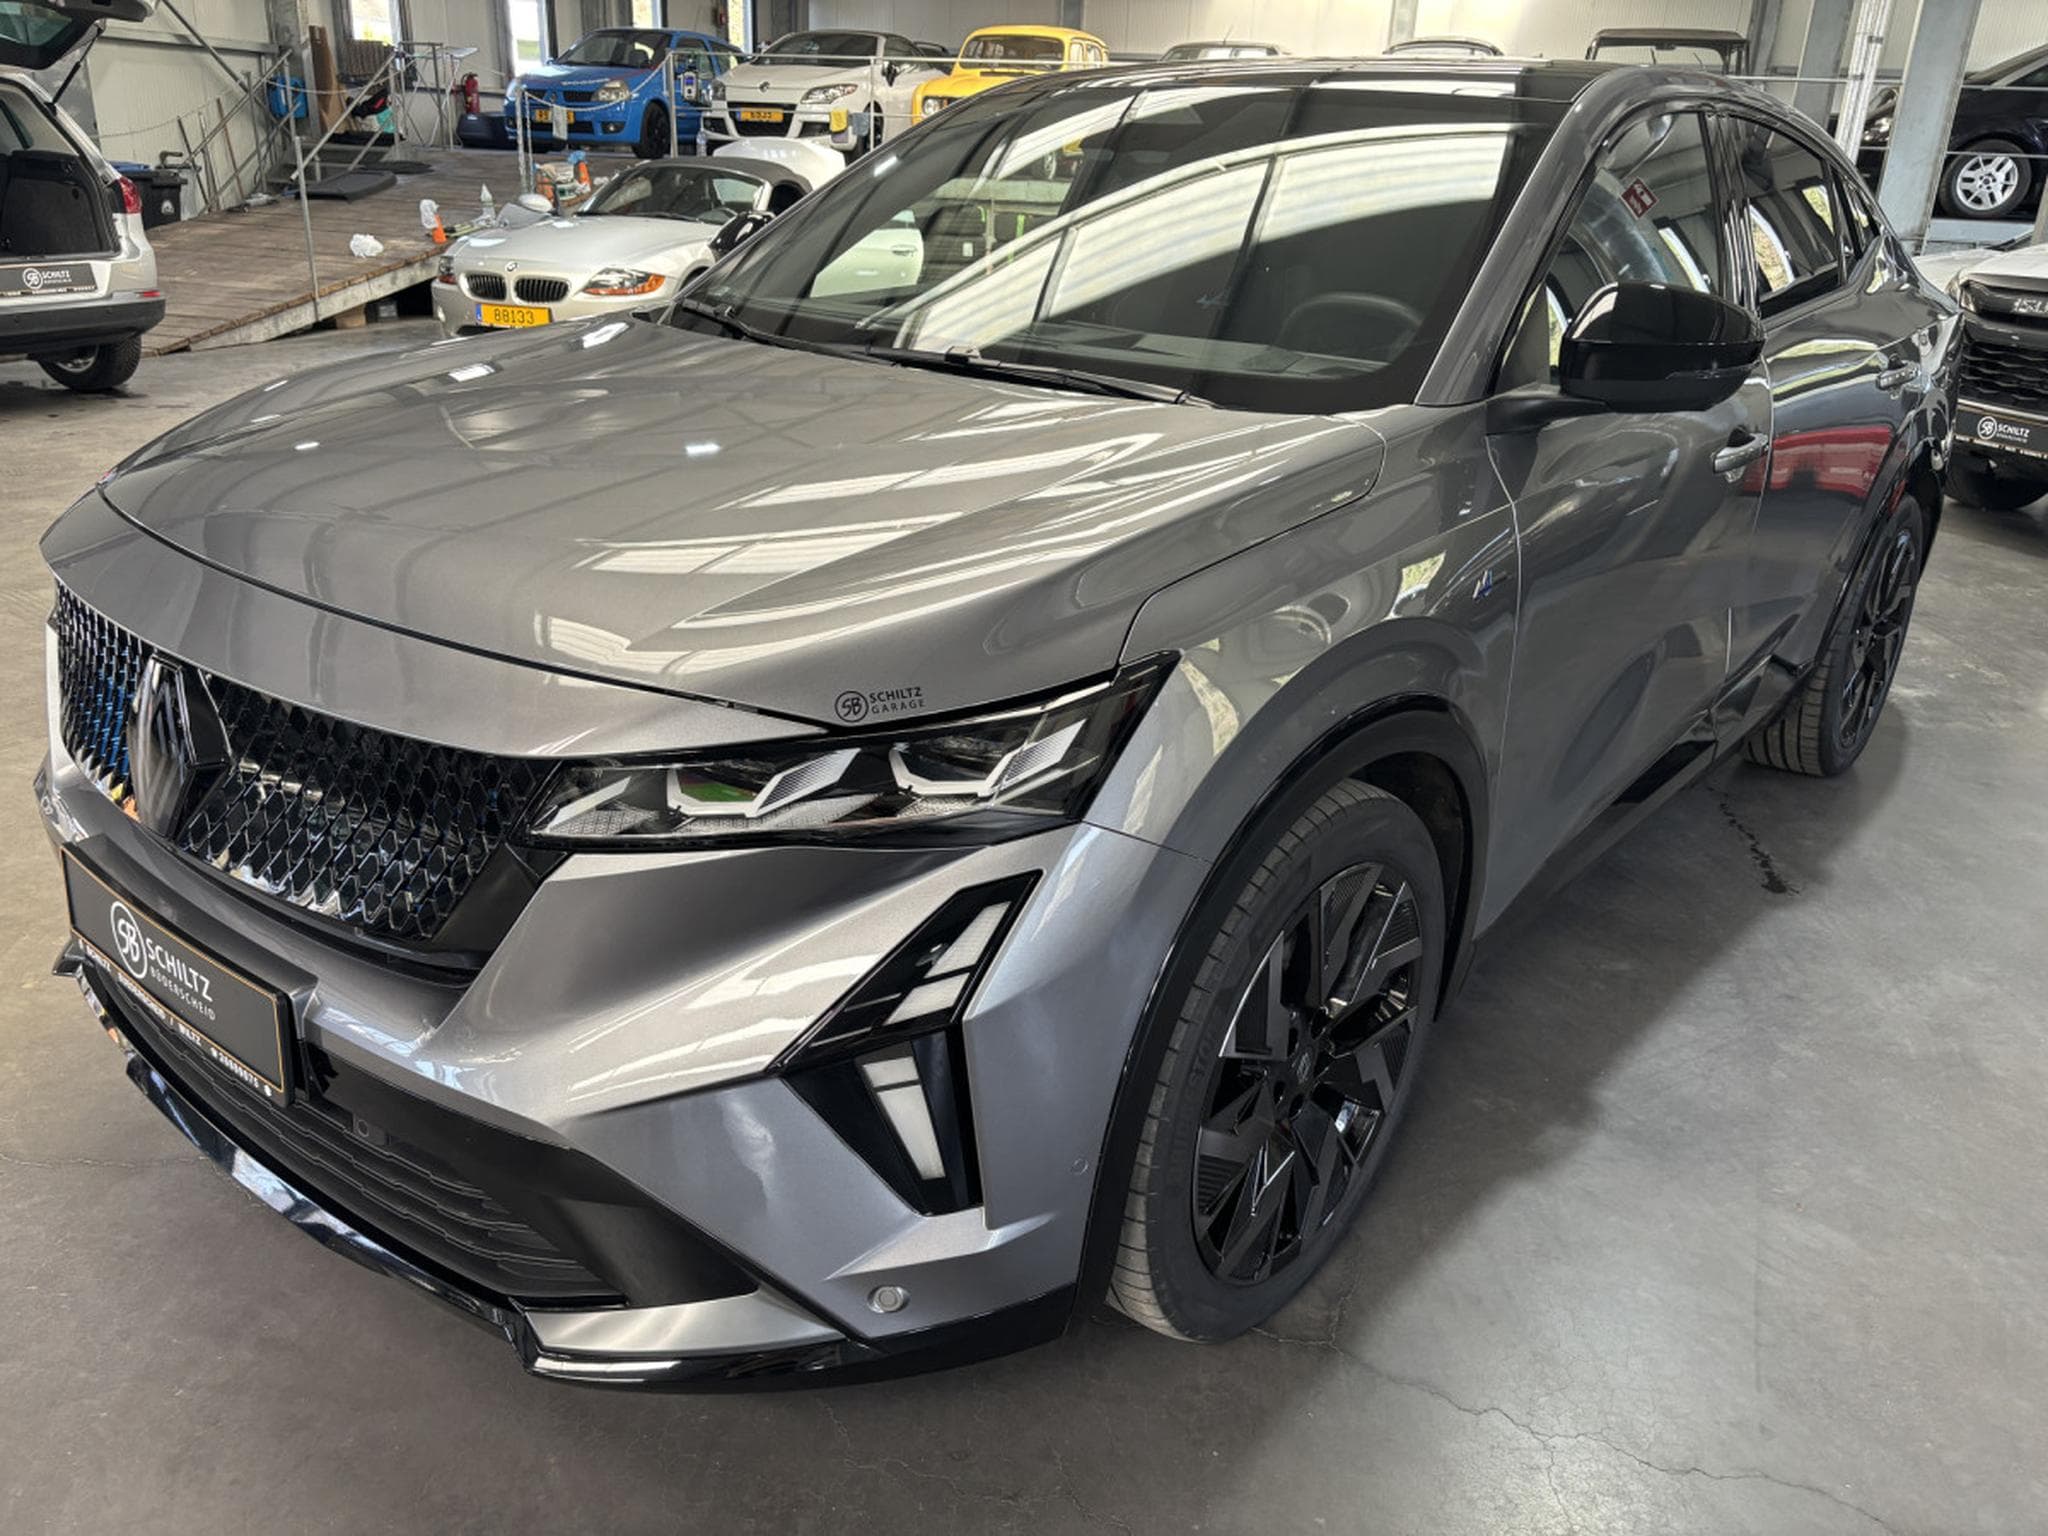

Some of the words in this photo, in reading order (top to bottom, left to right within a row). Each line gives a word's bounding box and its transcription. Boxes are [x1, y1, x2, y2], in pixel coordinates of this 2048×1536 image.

[1997, 423, 2031, 438] SCHILTZ
[869, 687, 923, 704] SCHILTZ
[870, 699, 927, 714] GARAGE
[145, 937, 214, 1003] SCHILTZ
